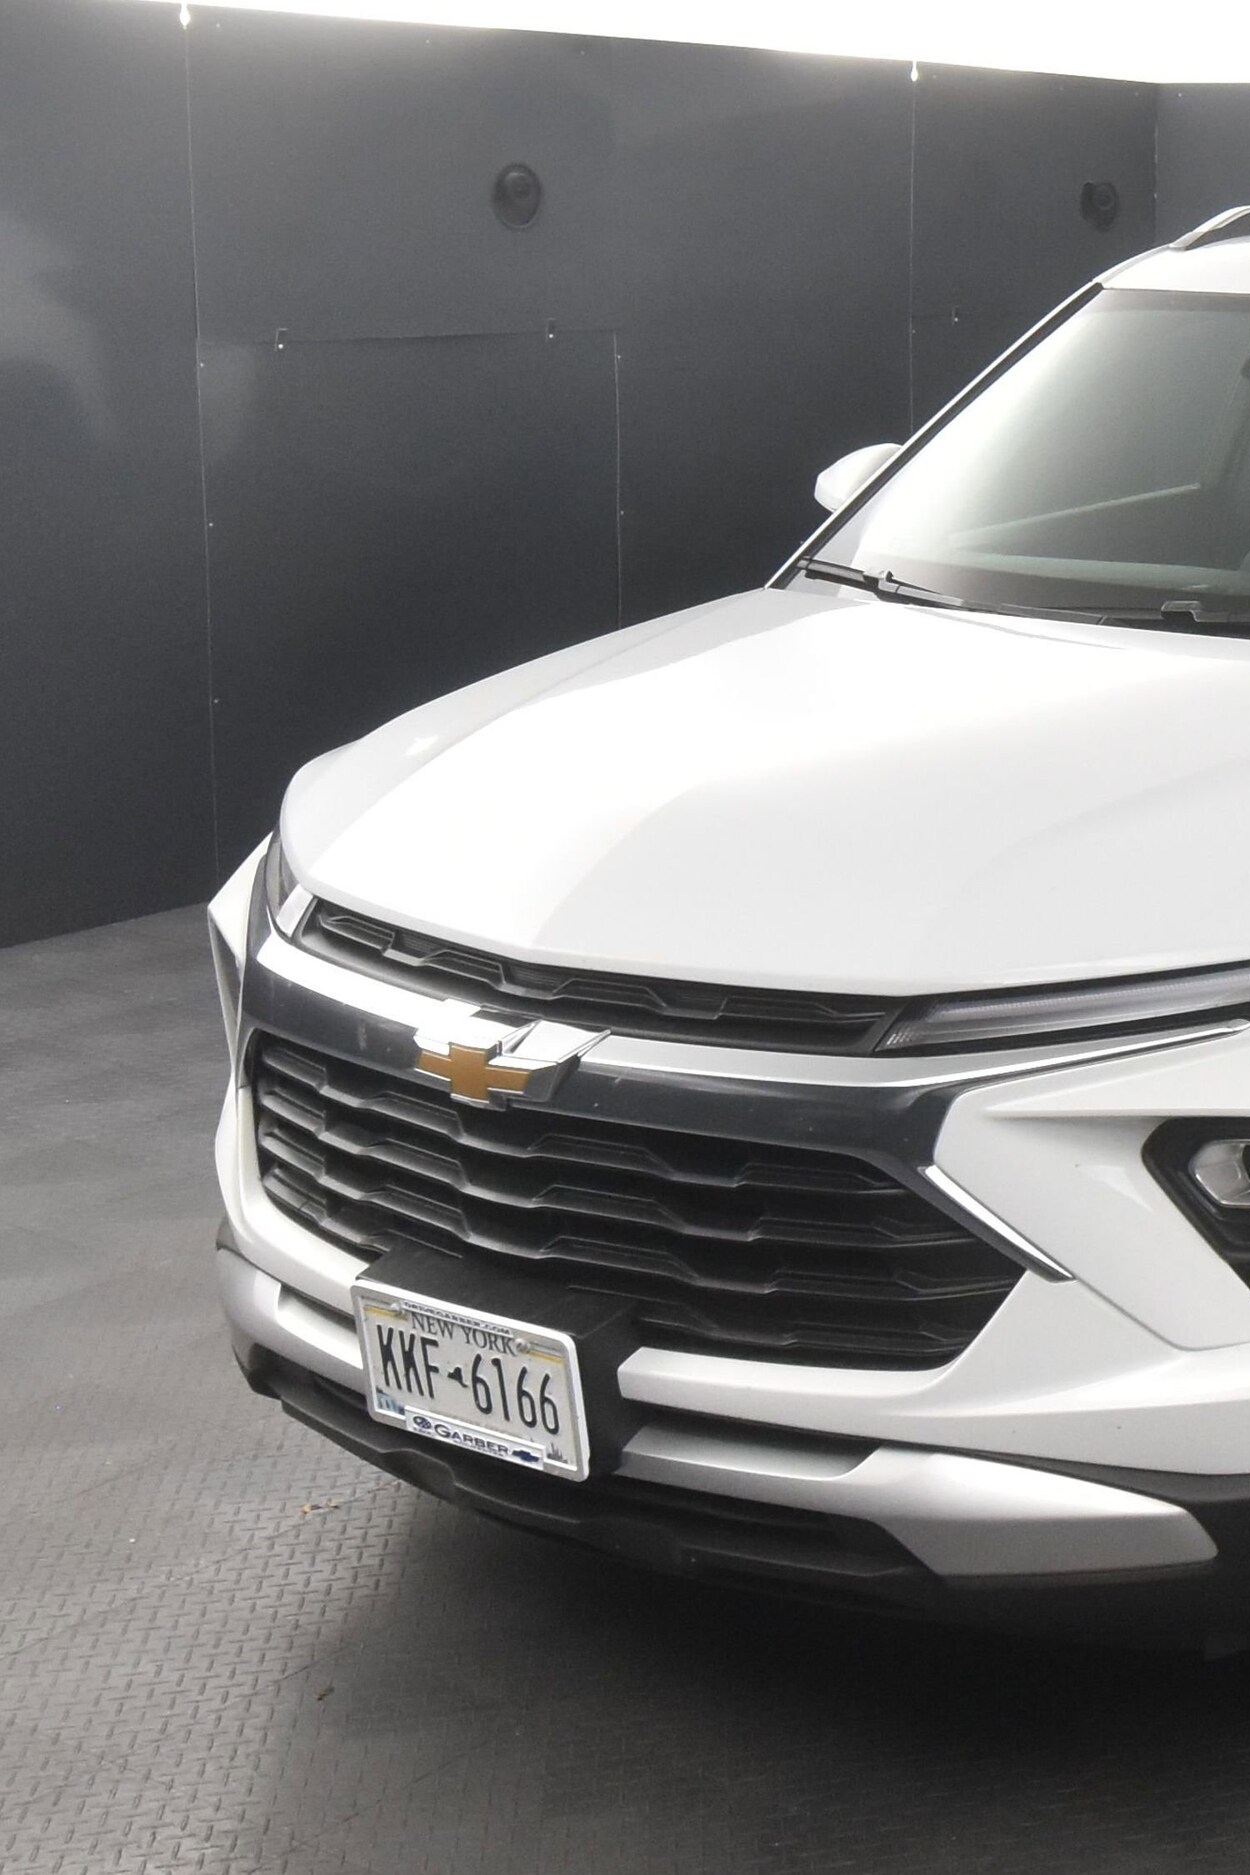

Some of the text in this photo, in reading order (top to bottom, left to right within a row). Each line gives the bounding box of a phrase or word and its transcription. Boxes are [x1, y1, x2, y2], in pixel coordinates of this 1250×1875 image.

[411, 1312, 517, 1357] NEW YORK
[434, 1423, 509, 1456] GARBER
